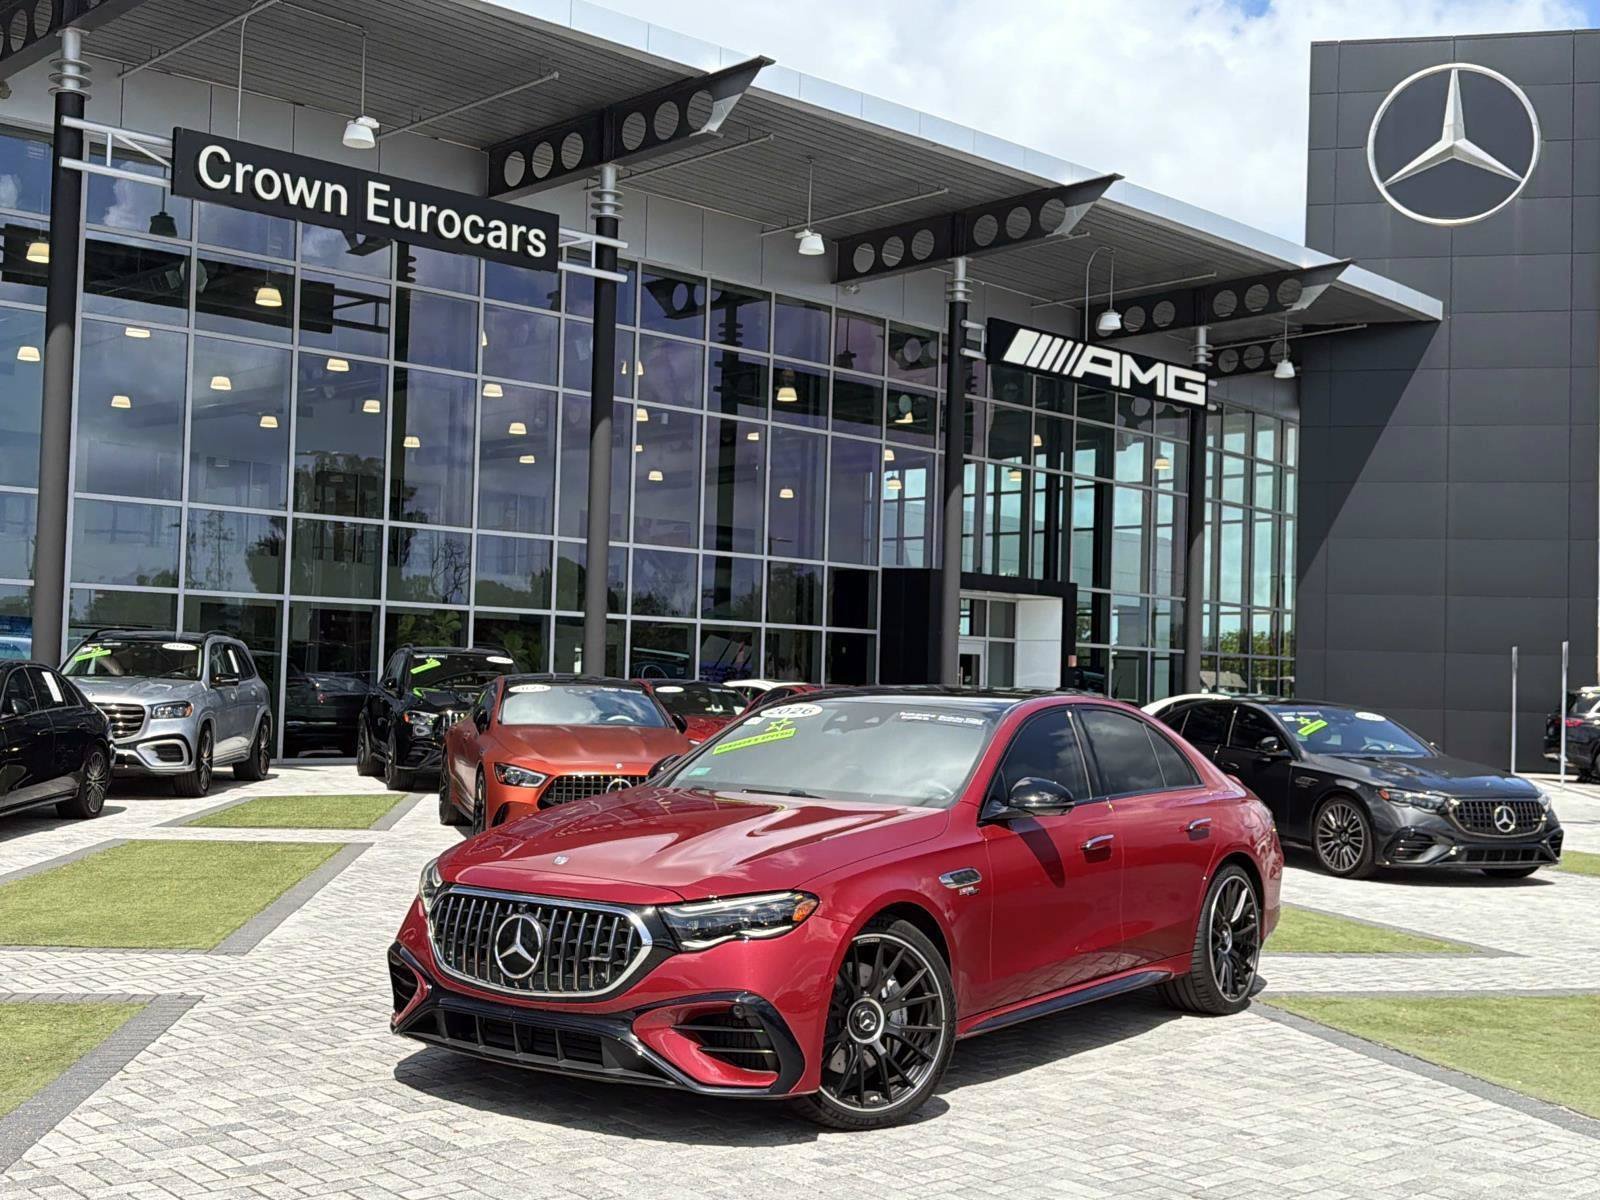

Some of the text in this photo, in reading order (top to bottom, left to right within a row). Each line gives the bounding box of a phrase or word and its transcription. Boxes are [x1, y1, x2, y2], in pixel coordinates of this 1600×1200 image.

[198, 144, 547, 258] Crown Eurocars
[1072, 344, 1206, 406] AMG
[767, 706, 817, 716] 2026
